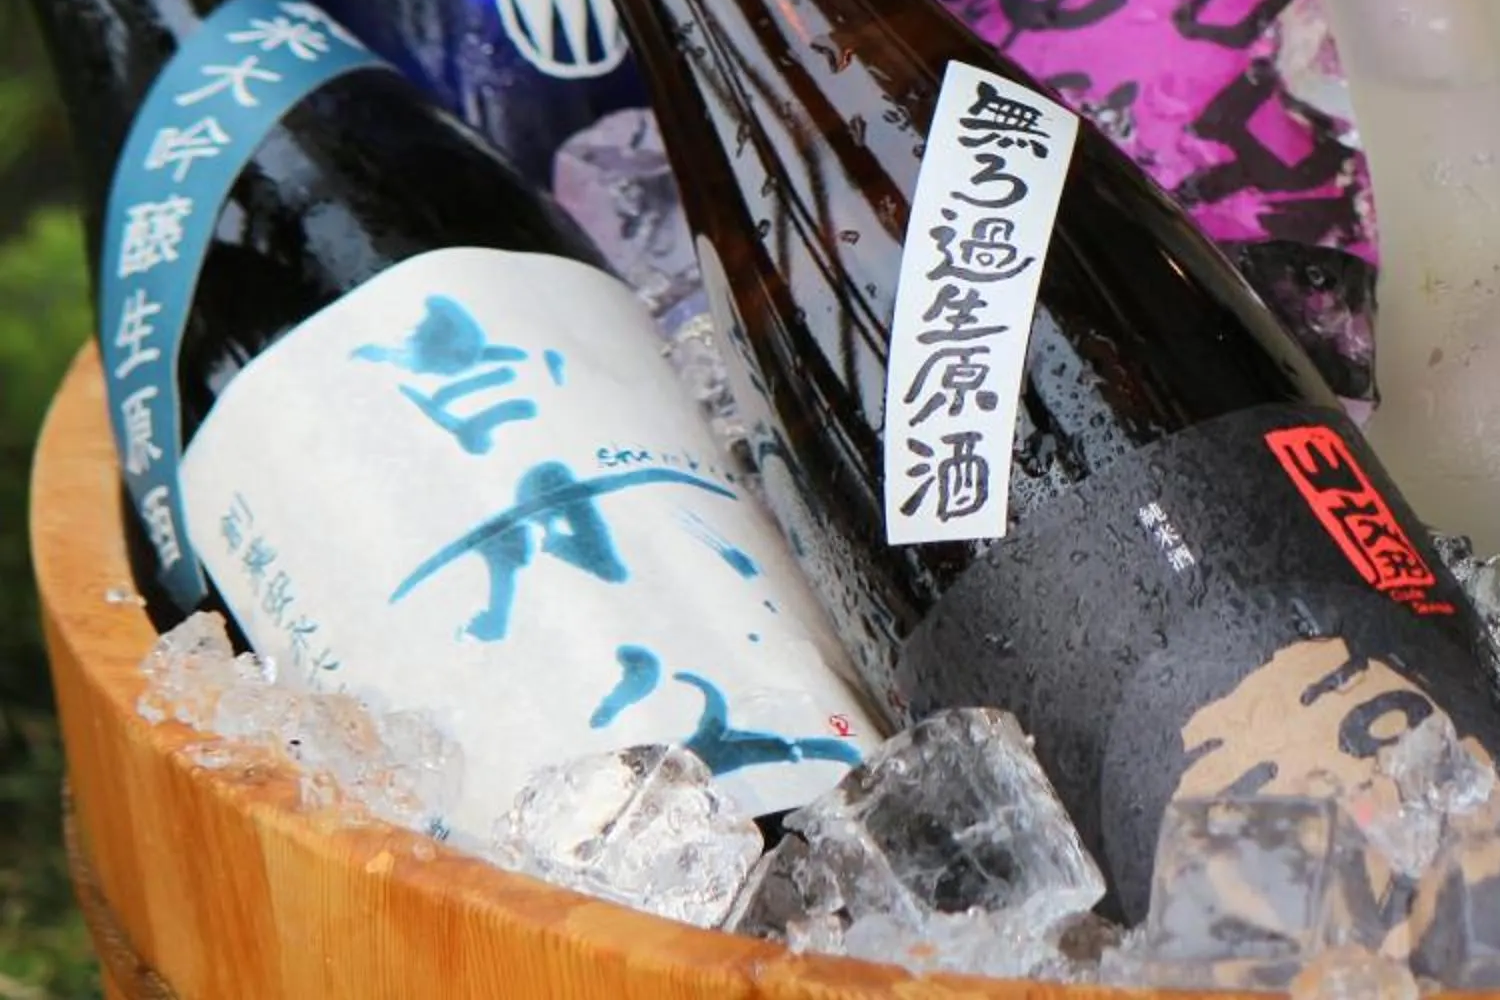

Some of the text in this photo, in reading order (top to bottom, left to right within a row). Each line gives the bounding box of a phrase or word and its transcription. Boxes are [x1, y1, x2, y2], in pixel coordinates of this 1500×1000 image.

[898, 80, 1055, 521] 無ろ過生原酒
[1137, 500, 1197, 573] 純米酒
